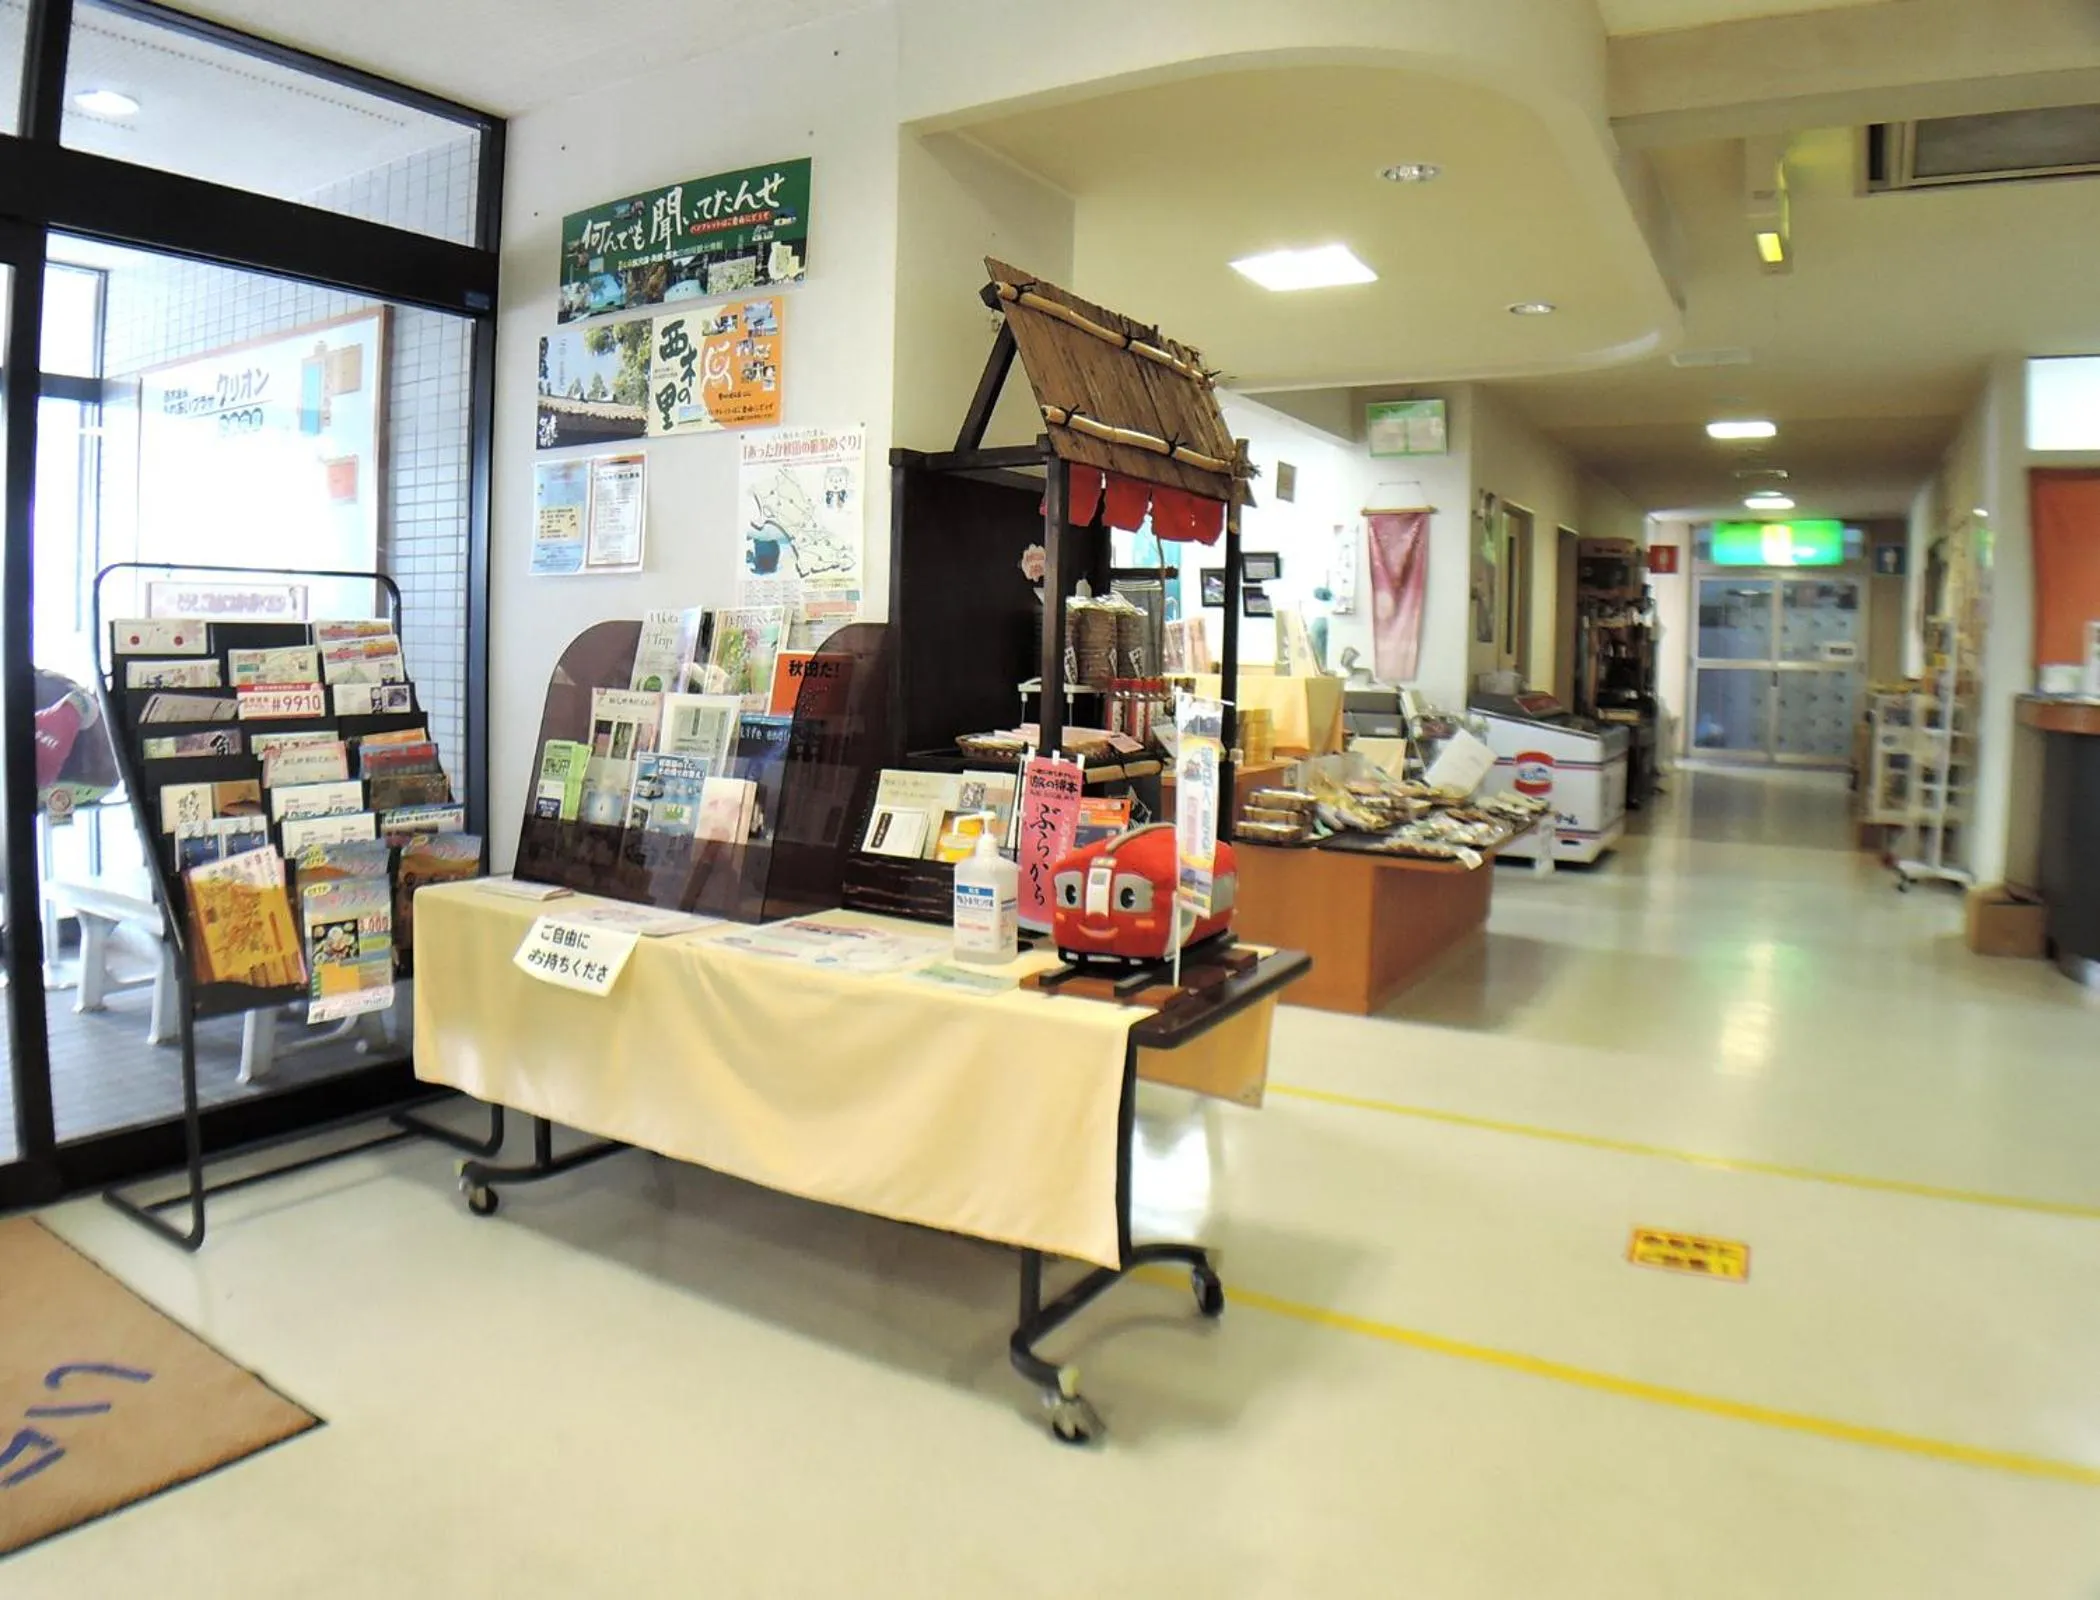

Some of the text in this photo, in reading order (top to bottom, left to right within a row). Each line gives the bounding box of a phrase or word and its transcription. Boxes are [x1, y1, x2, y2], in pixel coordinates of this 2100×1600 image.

[581, 173, 785, 254] 何んでも聞いてたんせ
[540, 924, 591, 949] ご自由に
[527, 947, 609, 983] お持ちくださ
